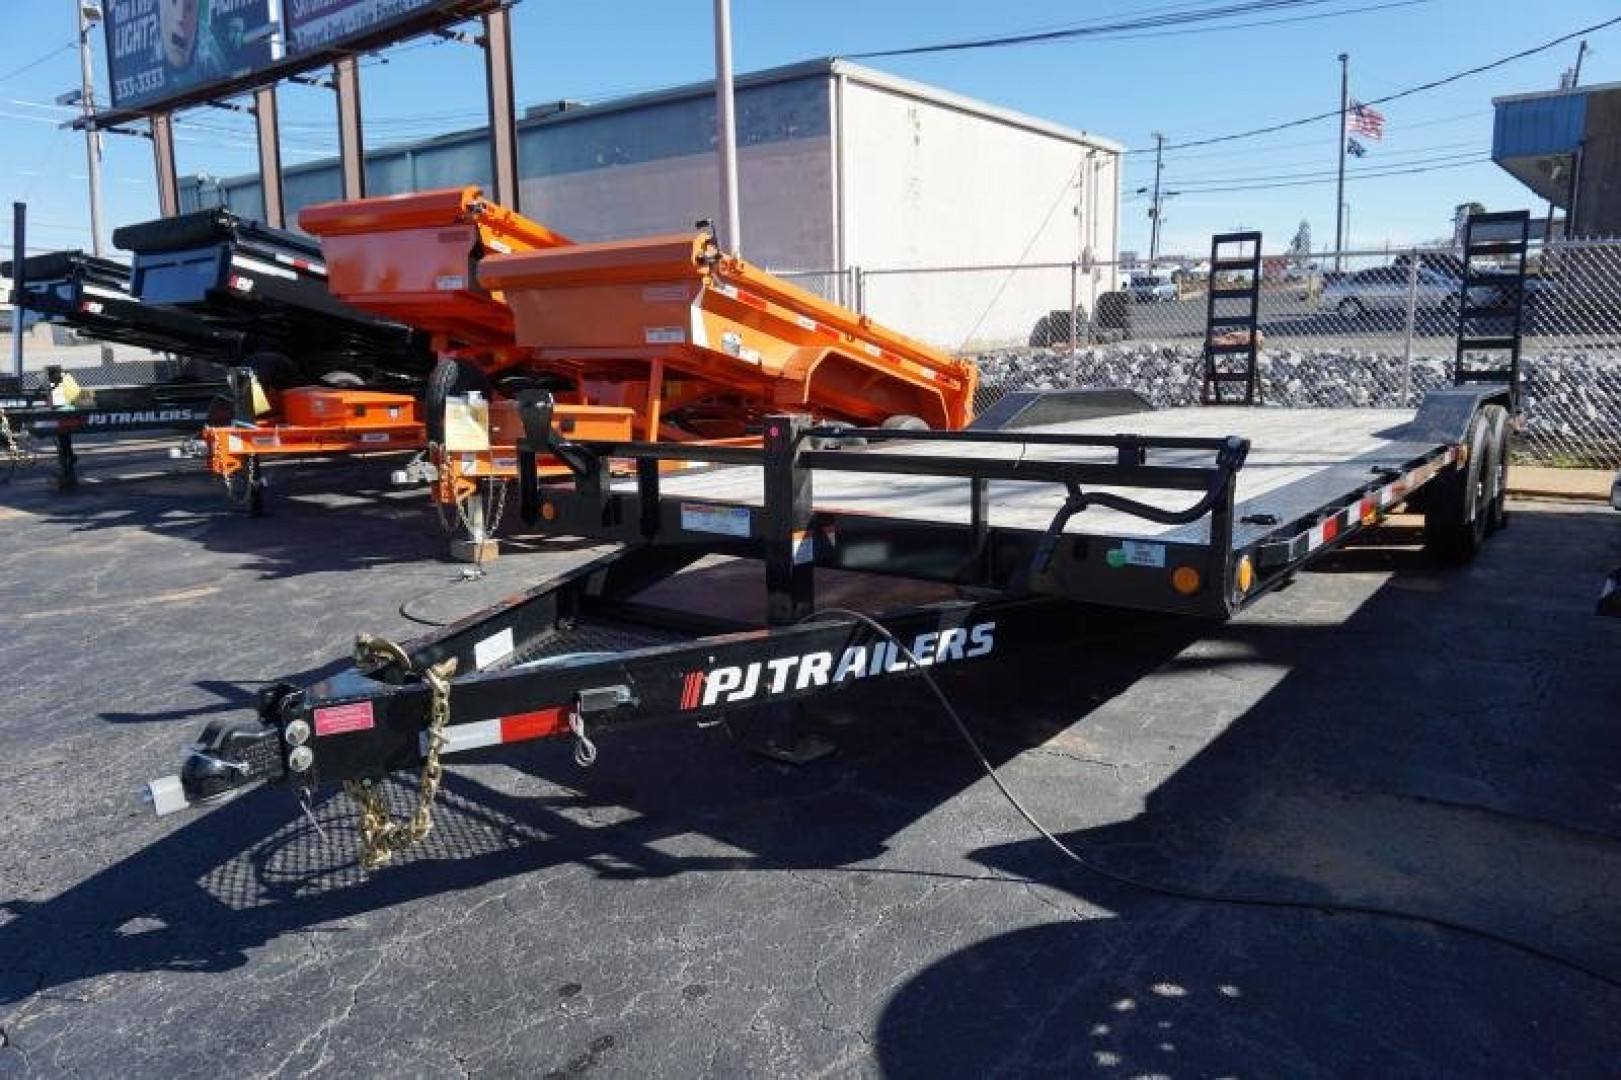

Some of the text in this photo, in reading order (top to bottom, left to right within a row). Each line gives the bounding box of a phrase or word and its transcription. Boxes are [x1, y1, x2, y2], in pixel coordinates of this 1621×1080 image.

[115, 14, 157, 57] LIGHT?
[702, 622, 996, 706] PJ TRAILERS
